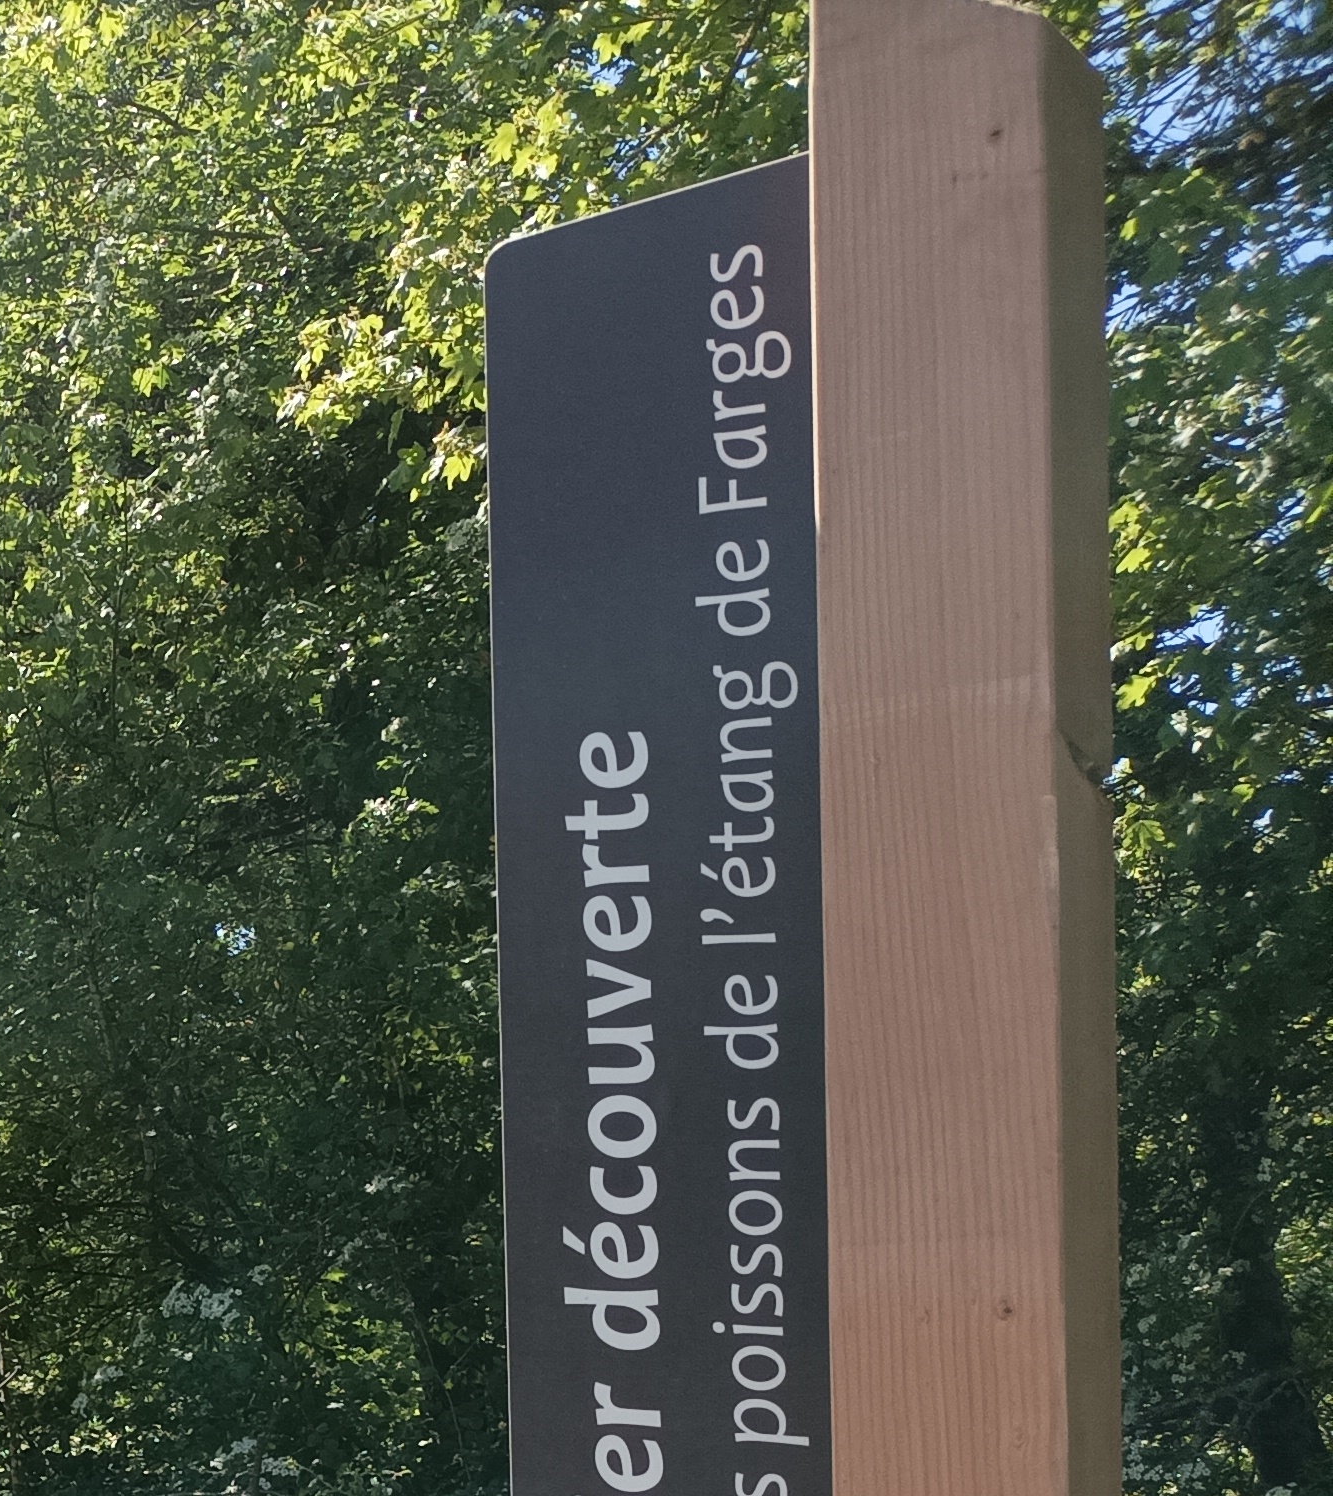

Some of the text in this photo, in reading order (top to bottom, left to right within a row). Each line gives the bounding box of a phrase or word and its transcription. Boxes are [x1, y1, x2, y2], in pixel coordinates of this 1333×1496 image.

[699, 245, 791, 514] Farges
[695, 540, 770, 636] de
[701, 662, 798, 944] l'étang
[563, 732, 660, 1350] découverte
[704, 975, 778, 1069] de
[713, 1098, 809, 1446] poissons
